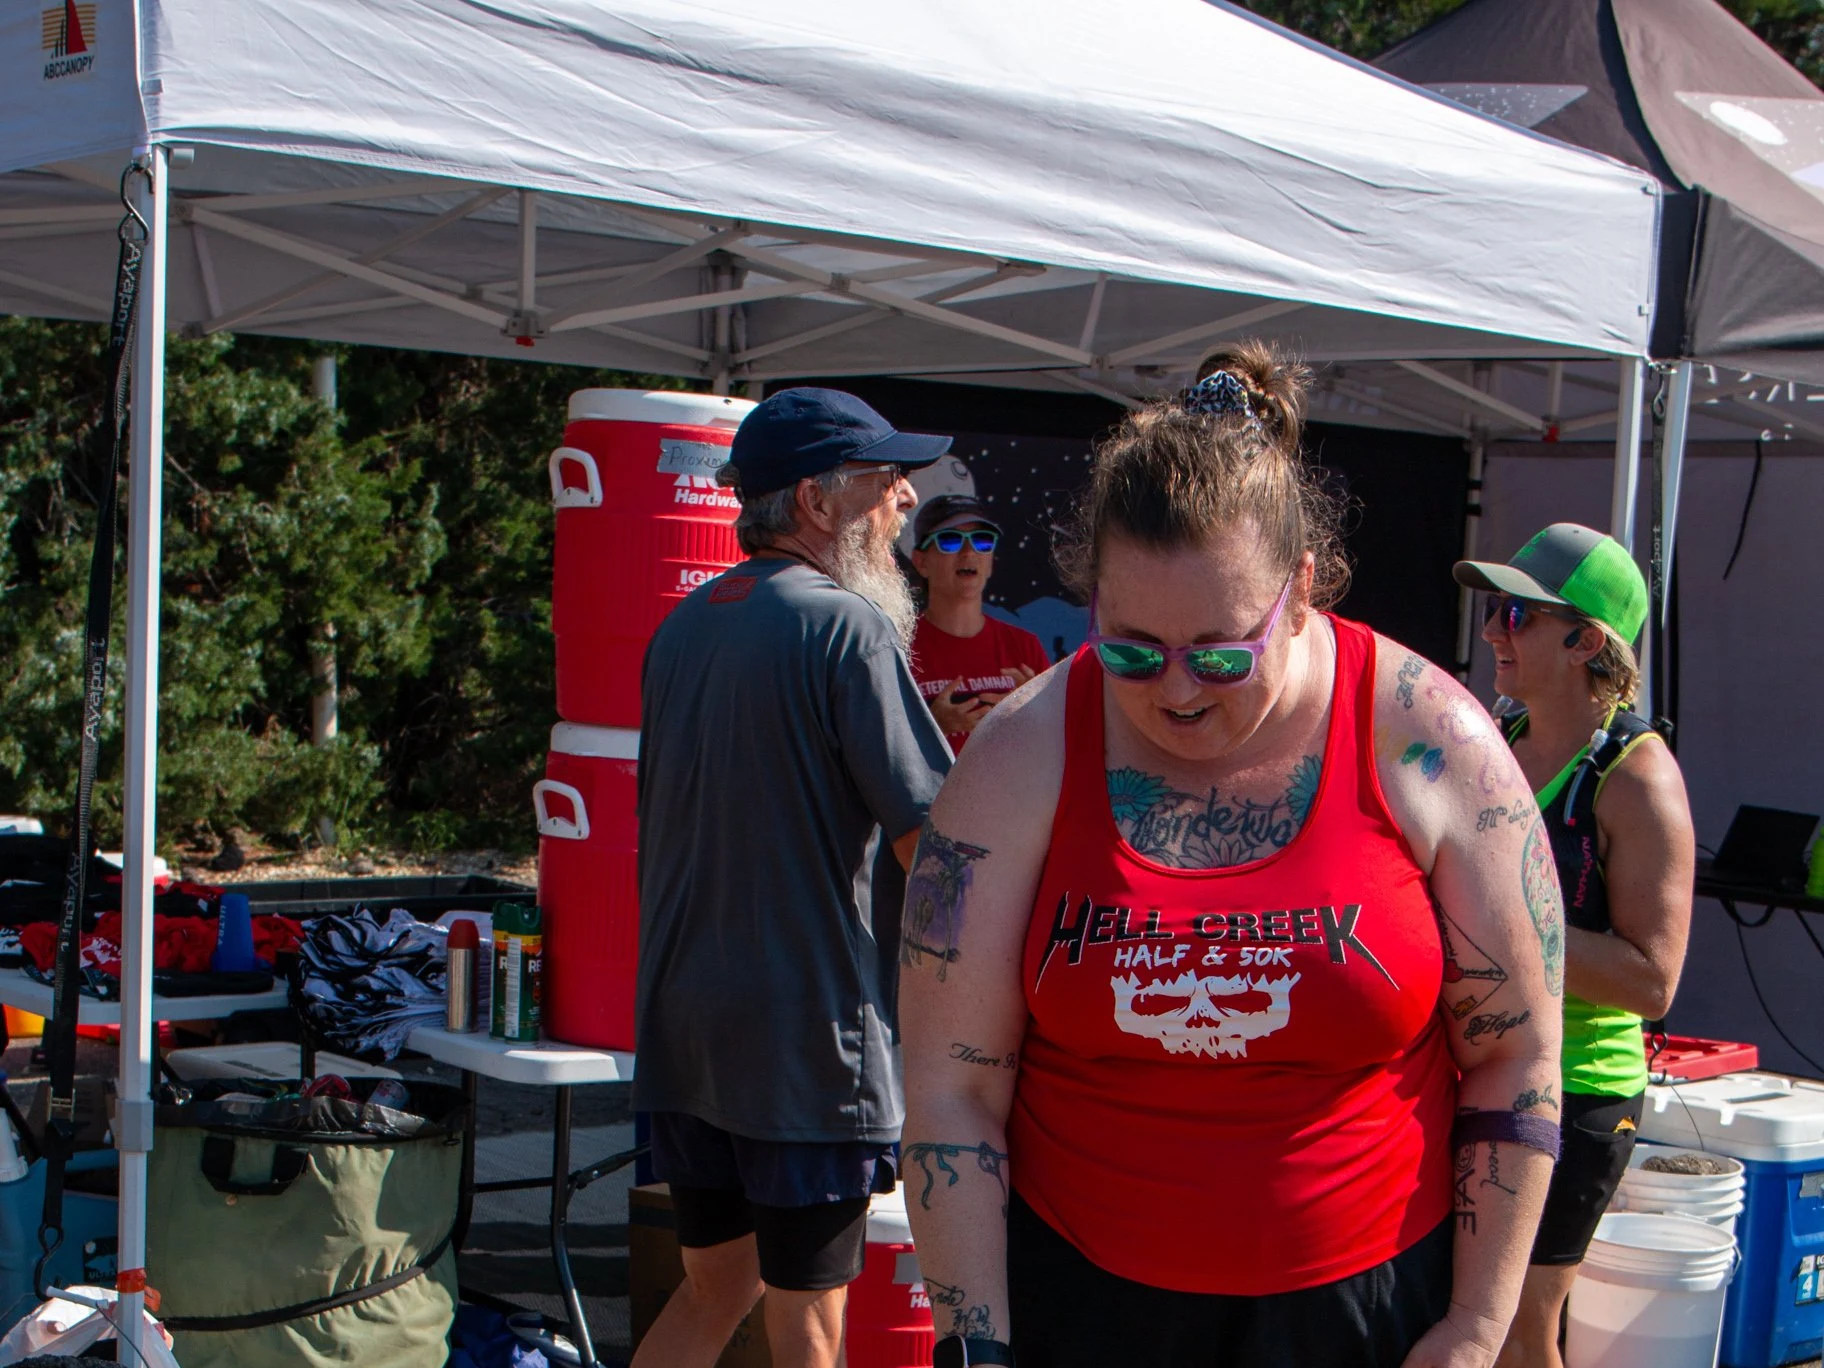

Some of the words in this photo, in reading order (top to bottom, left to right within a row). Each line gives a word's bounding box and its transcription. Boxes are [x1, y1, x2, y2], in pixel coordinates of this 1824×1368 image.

[43, 55, 94, 80] ABCCANOPY
[112, 243, 142, 346] Ayaport
[85, 637, 106, 742] Ayaport
[1035, 890, 1174, 994] HELL
[1193, 904, 1400, 991] CREEK
[1114, 943, 1191, 969] HALF
[1202, 945, 1227, 967] &
[1238, 947, 1294, 969] 50K
